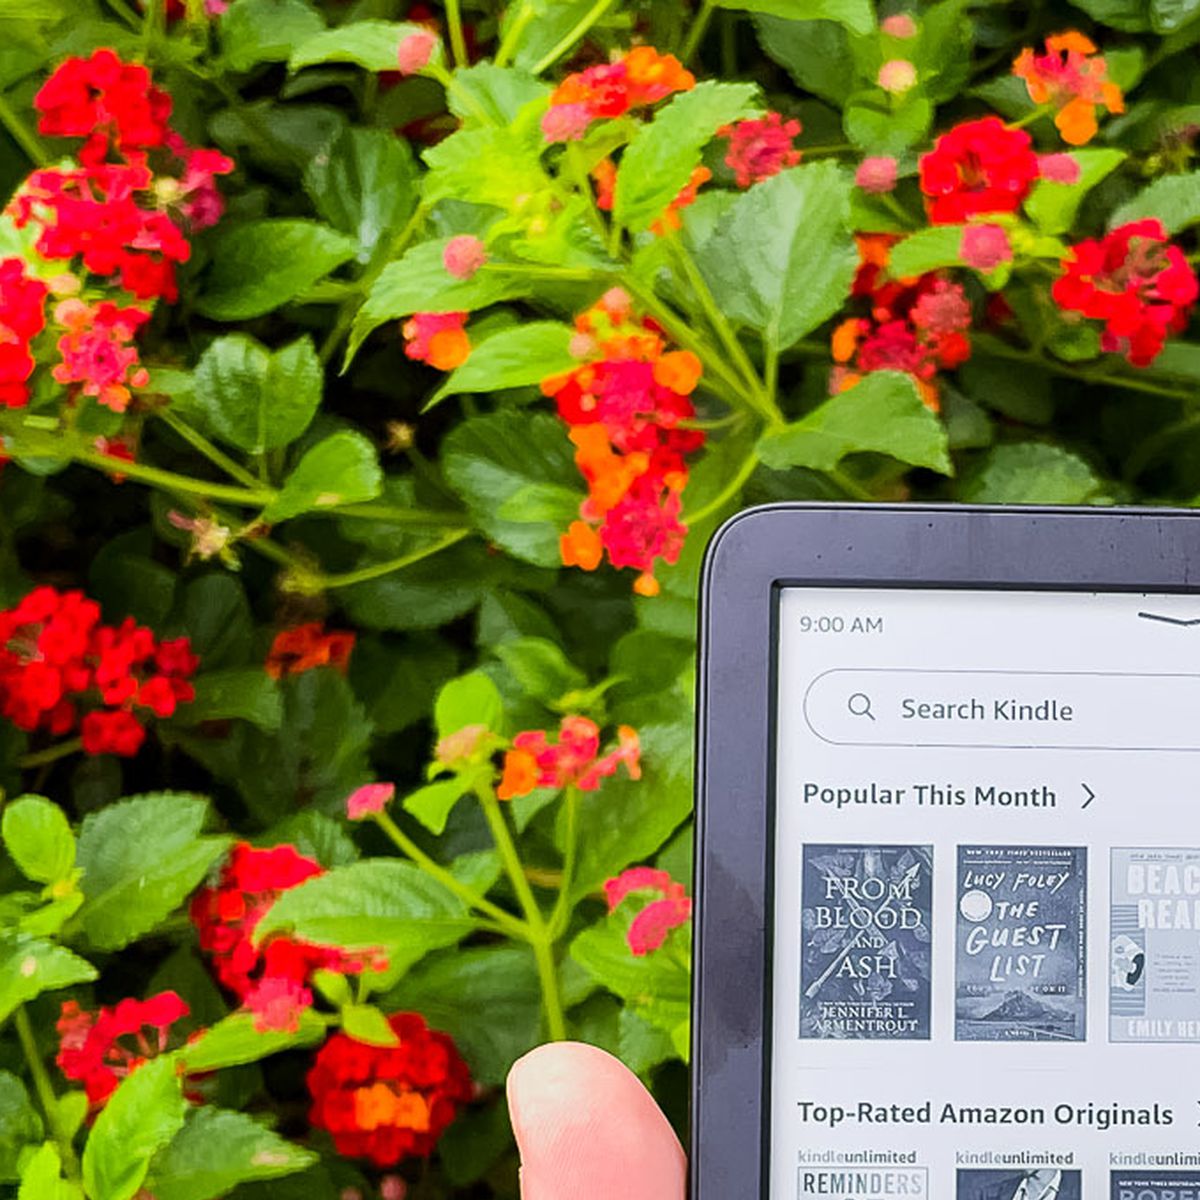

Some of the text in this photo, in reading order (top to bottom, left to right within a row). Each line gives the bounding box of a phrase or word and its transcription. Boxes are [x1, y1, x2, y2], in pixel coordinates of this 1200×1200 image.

[800, 616, 884, 633] 9:00 AM
[901, 698, 1073, 721] Search Kindle
[803, 783, 1057, 808] Popular This Month
[822, 877, 913, 900] FROM
[963, 870, 1070, 894] LUCY FOLEY
[815, 906, 921, 929] BLOOD
[995, 902, 1039, 920] THE
[851, 936, 884, 949] AND
[966, 924, 1067, 955] GUEST
[836, 956, 897, 979] ASH
[990, 955, 1046, 981] LIST
[822, 1007, 894, 1020] JENNIFER
[812, 1019, 919, 1032] ARMENTROUT
[1128, 1020, 1172, 1037] EMILY
[797, 1101, 1174, 1129] Top-Rated Amazon Originals
[803, 1173, 922, 1194] REMINDERS
